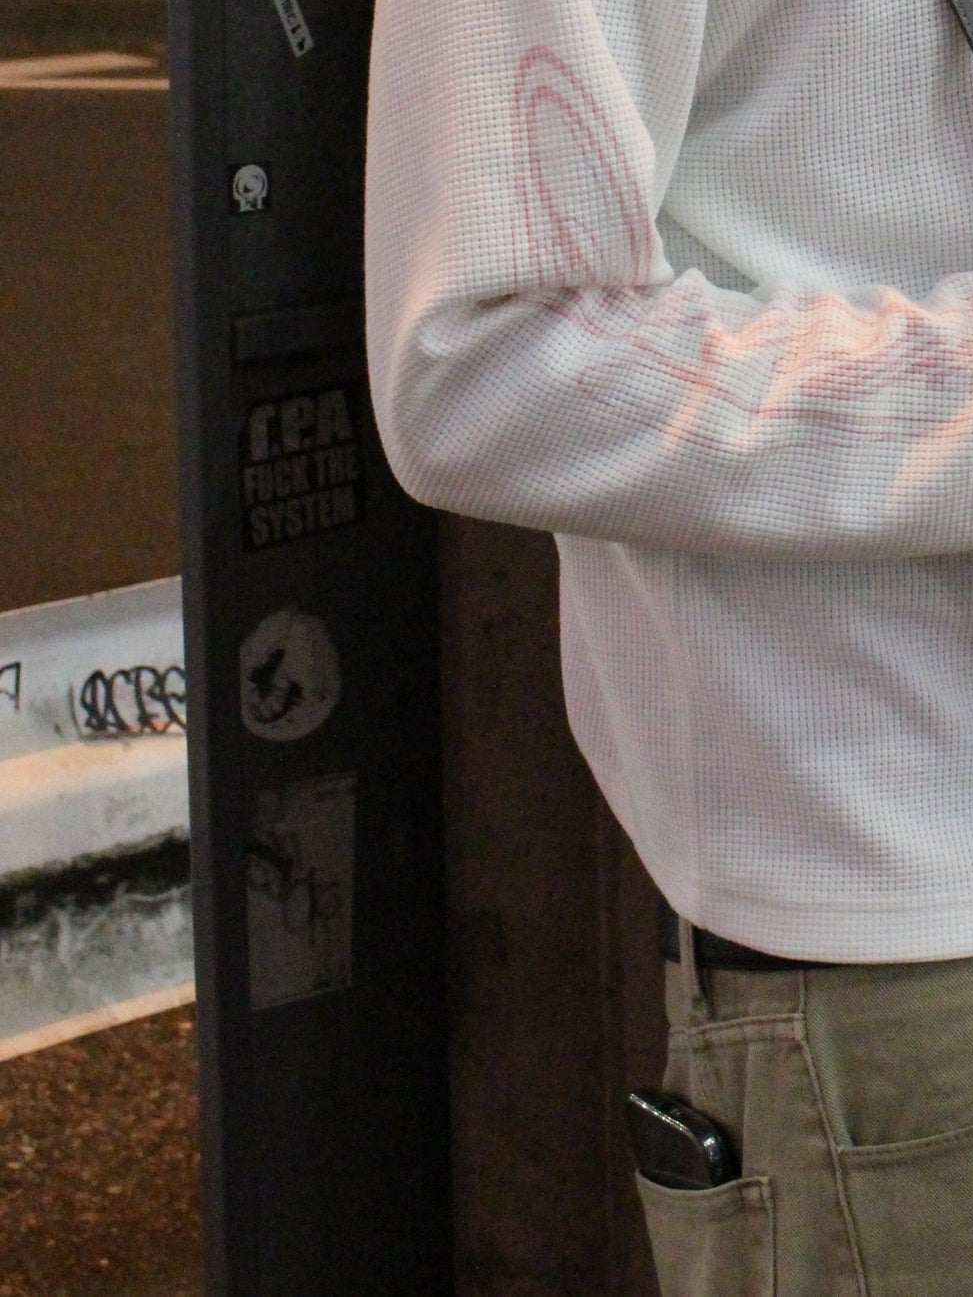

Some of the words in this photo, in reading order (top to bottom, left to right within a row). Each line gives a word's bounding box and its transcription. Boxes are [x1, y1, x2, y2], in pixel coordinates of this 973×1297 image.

[243, 454, 310, 506] FUCK
[312, 443, 359, 487] THE
[250, 485, 357, 545] SYSTEM
